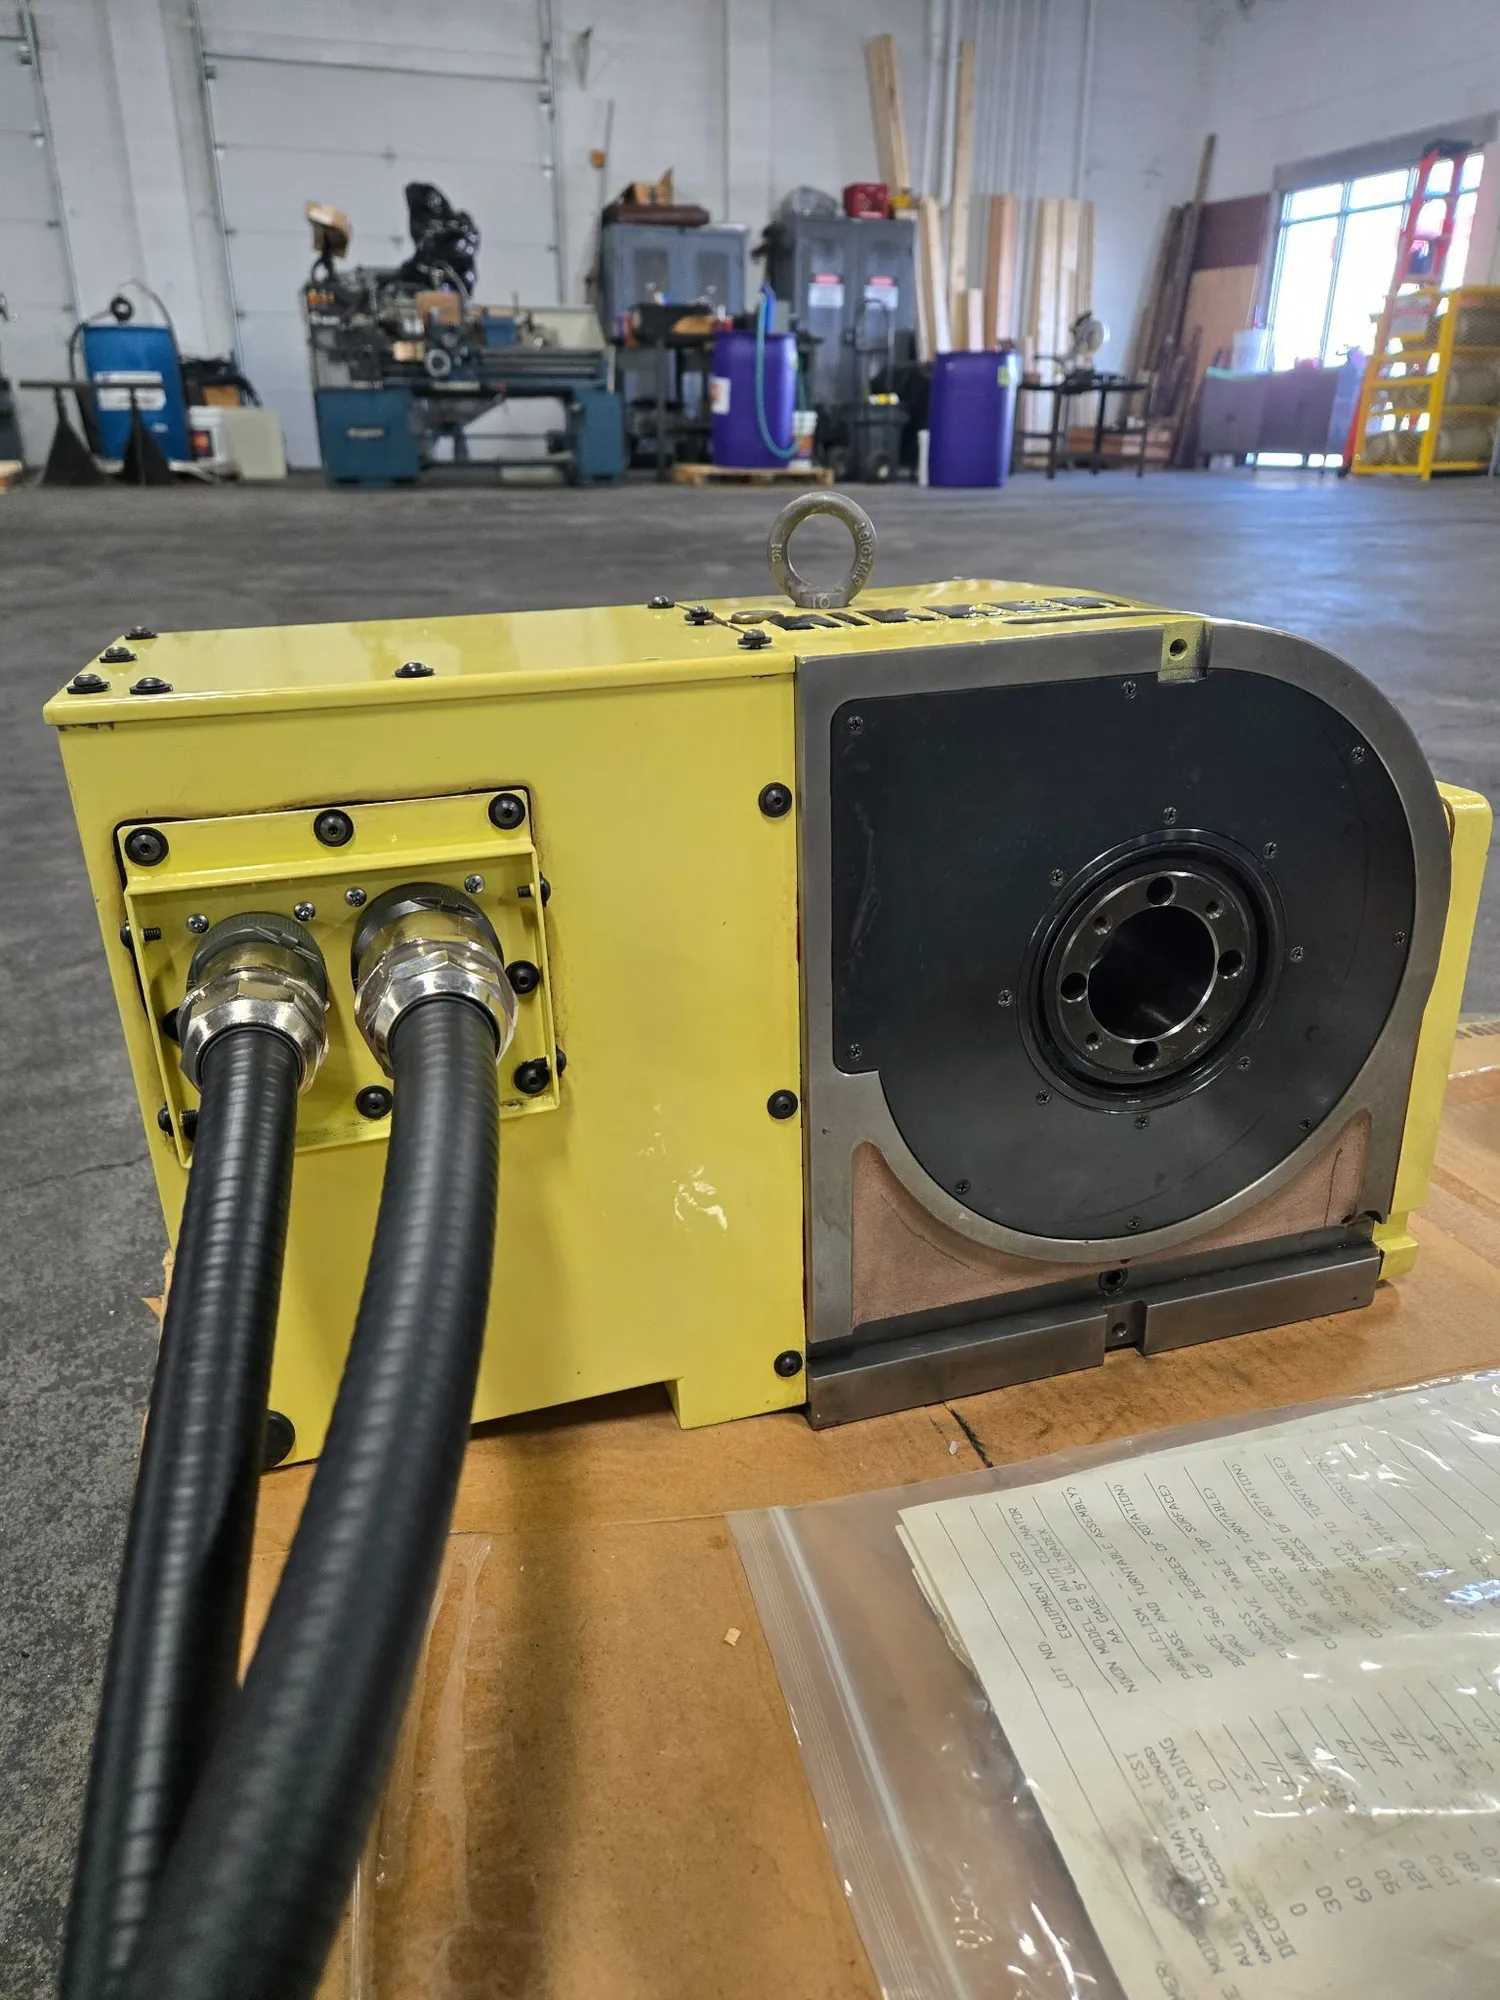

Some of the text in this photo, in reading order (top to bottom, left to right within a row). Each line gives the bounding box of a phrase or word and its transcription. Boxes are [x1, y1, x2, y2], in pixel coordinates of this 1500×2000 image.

[1230, 1465, 1274, 1517] ROTATION)
[1271, 1456, 1320, 1517] TURNTABLE)
[1065, 1487, 1104, 1537] ASSEMBLY)
[1113, 1485, 1153, 1535] ROTATION)
[1157, 1486, 1195, 1532] SURFACE)
[1007, 1506, 1050, 1563] COLLIMATOR
[1272, 1523, 1290, 1533] OF
[1322, 1522, 1338, 1535] TO
[1360, 1511, 1409, 1556] VRTICAL
[1037, 1528, 1075, 1574] ULTRADEX
[1150, 1541, 1167, 1552] OF
[1195, 1537, 1214, 1552] TOP
[1202, 1489, 1308, 1606] CENTER OF TURNTABLE)
[1272, 1539, 1308, 1571] RUNOUT
[1047, 1568, 1070, 1591] AUTO
[1102, 1543, 1146, 1596] TURNTABLE
[1165, 1557, 1205, 1599] DEGREES
[1214, 1559, 1242, 1591] TABLE
[1010, 1551, 1071, 1638] EQUIPMENT USED
[1241, 1555, 1301, 1617] DEFLECTION
[1306, 1576, 1339, 1604] HOLE
[1084, 1595, 1108, 1622] GAGE
[1146, 1601, 1167, 1620] AND
[1203, 1606, 1224, 1627] 360
[1081, 1619, 1110, 1651] MODEL
[1132, 1607, 1193, 1678] PARALLELISM
[1165, 1630, 1193, 1656] BASE
[1050, 1663, 1074, 1687] LOT
[1106, 1660, 1138, 1692] NIKON
[1124, 1752, 1152, 1789] TEST
[1143, 1747, 1180, 1799] SECONDS)
[1158, 1737, 1211, 1811] READING
[1188, 1828, 1230, 1887] ACCURACY
[1426, 1856, 1462, 1885] 150
[1344, 1876, 1372, 1902] 60
[1373, 1869, 1399, 1892] 90
[1397, 1860, 1431, 1888] 120
[1289, 1903, 1307, 1915] 0
[1314, 1886, 1344, 1912] 30
